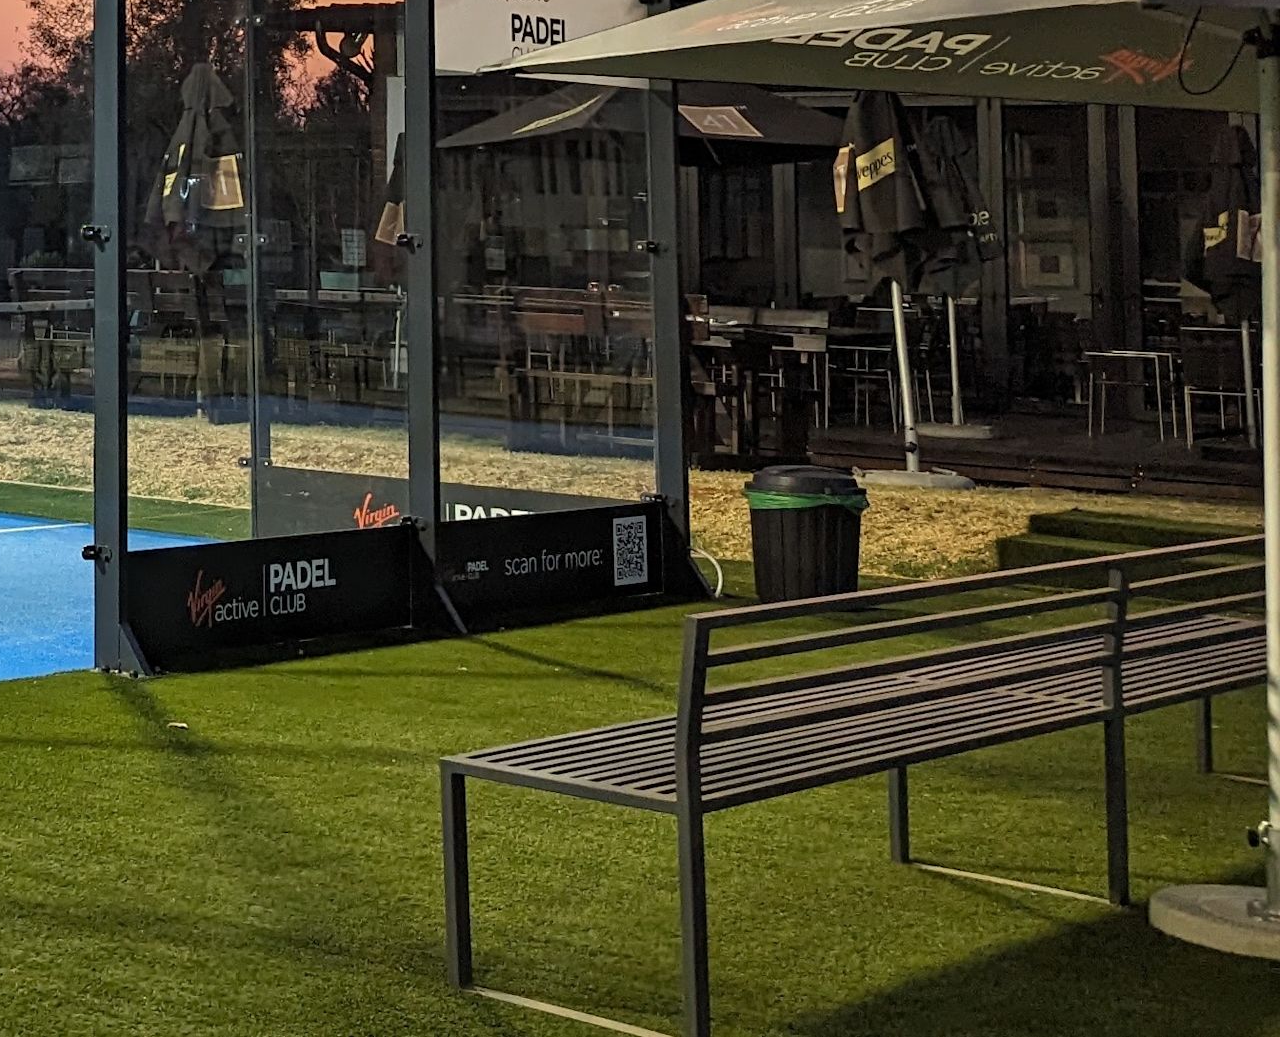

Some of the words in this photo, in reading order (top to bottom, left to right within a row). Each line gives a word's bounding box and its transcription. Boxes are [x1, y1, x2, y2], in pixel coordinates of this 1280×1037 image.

[352, 491, 400, 530] Virgin
[269, 558, 337, 594] PADEL
[504, 556, 538, 577] scan
[541, 549, 562, 572] for
[565, 548, 604, 570] more:
[187, 569, 226, 629] Virgin
[214, 596, 260, 622] active
[269, 593, 307, 615] CLUB
